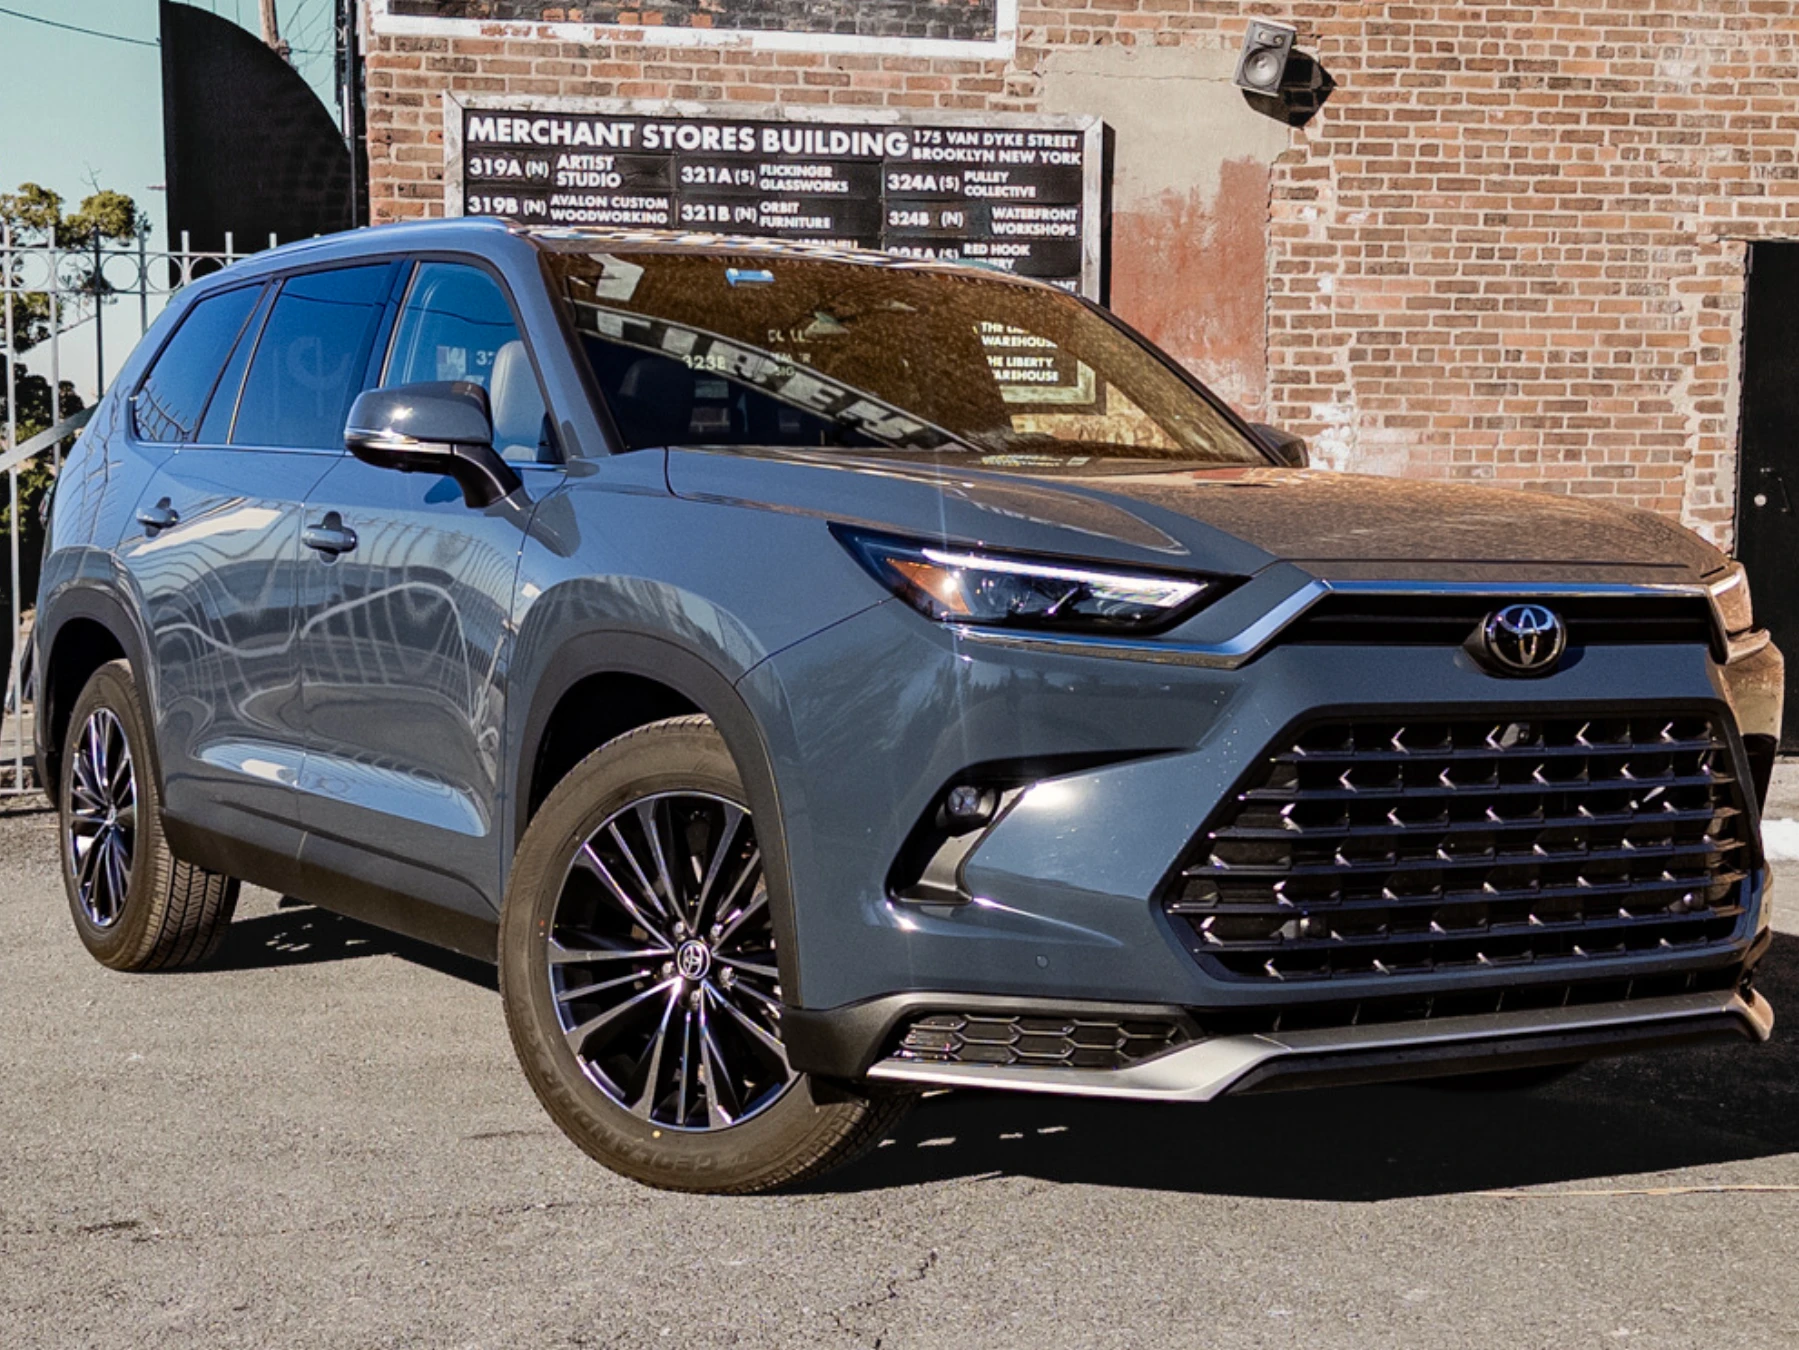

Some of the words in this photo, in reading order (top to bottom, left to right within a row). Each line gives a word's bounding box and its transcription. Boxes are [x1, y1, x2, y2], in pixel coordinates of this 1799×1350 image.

[467, 116, 635, 147] MERCHANT
[642, 123, 756, 153] STORES
[762, 128, 909, 157] BUILDING
[946, 131, 979, 146] VAN
[983, 133, 1024, 148] DYKE
[1027, 134, 1078, 149] STREET
[556, 154, 615, 171] ARTIST
[911, 147, 995, 163] BROOKLYN
[999, 149, 1035, 164] NEW
[1038, 150, 1082, 166] YORK
[469, 158, 522, 177] 319A
[525, 160, 549, 178] (N)
[759, 164, 833, 179] FLICKINGER
[556, 171, 623, 189] STUDIO
[681, 166, 733, 184] 321A
[734, 168, 756, 187] (S)
[887, 173, 938, 192] 324A
[939, 175, 960, 193] (S)
[964, 170, 1010, 184] PULLEY
[759, 179, 849, 194] GLASSWORKS
[964, 184, 1036, 198] COLLECTIVE
[467, 196, 518, 214] 319B
[523, 199, 547, 216] (N)
[550, 193, 606, 208] AVALON
[611, 196, 669, 210] CUSTOM
[759, 201, 800, 215] ORBIT
[550, 209, 669, 225] WOODWORKING
[681, 204, 730, 222] 321B
[734, 205, 757, 224] (N)
[887, 211, 930, 227] 324B
[940, 211, 963, 229] (N)
[991, 207, 1079, 222] WATERFRONT
[759, 216, 831, 230] FURNITURE
[991, 222, 1077, 237] WORKSHOPS
[963, 243, 988, 255] RED
[990, 243, 1031, 257] HOOK
[1006, 356, 1054, 369] LIBERTY
[992, 369, 1059, 382] AREHOUSE
